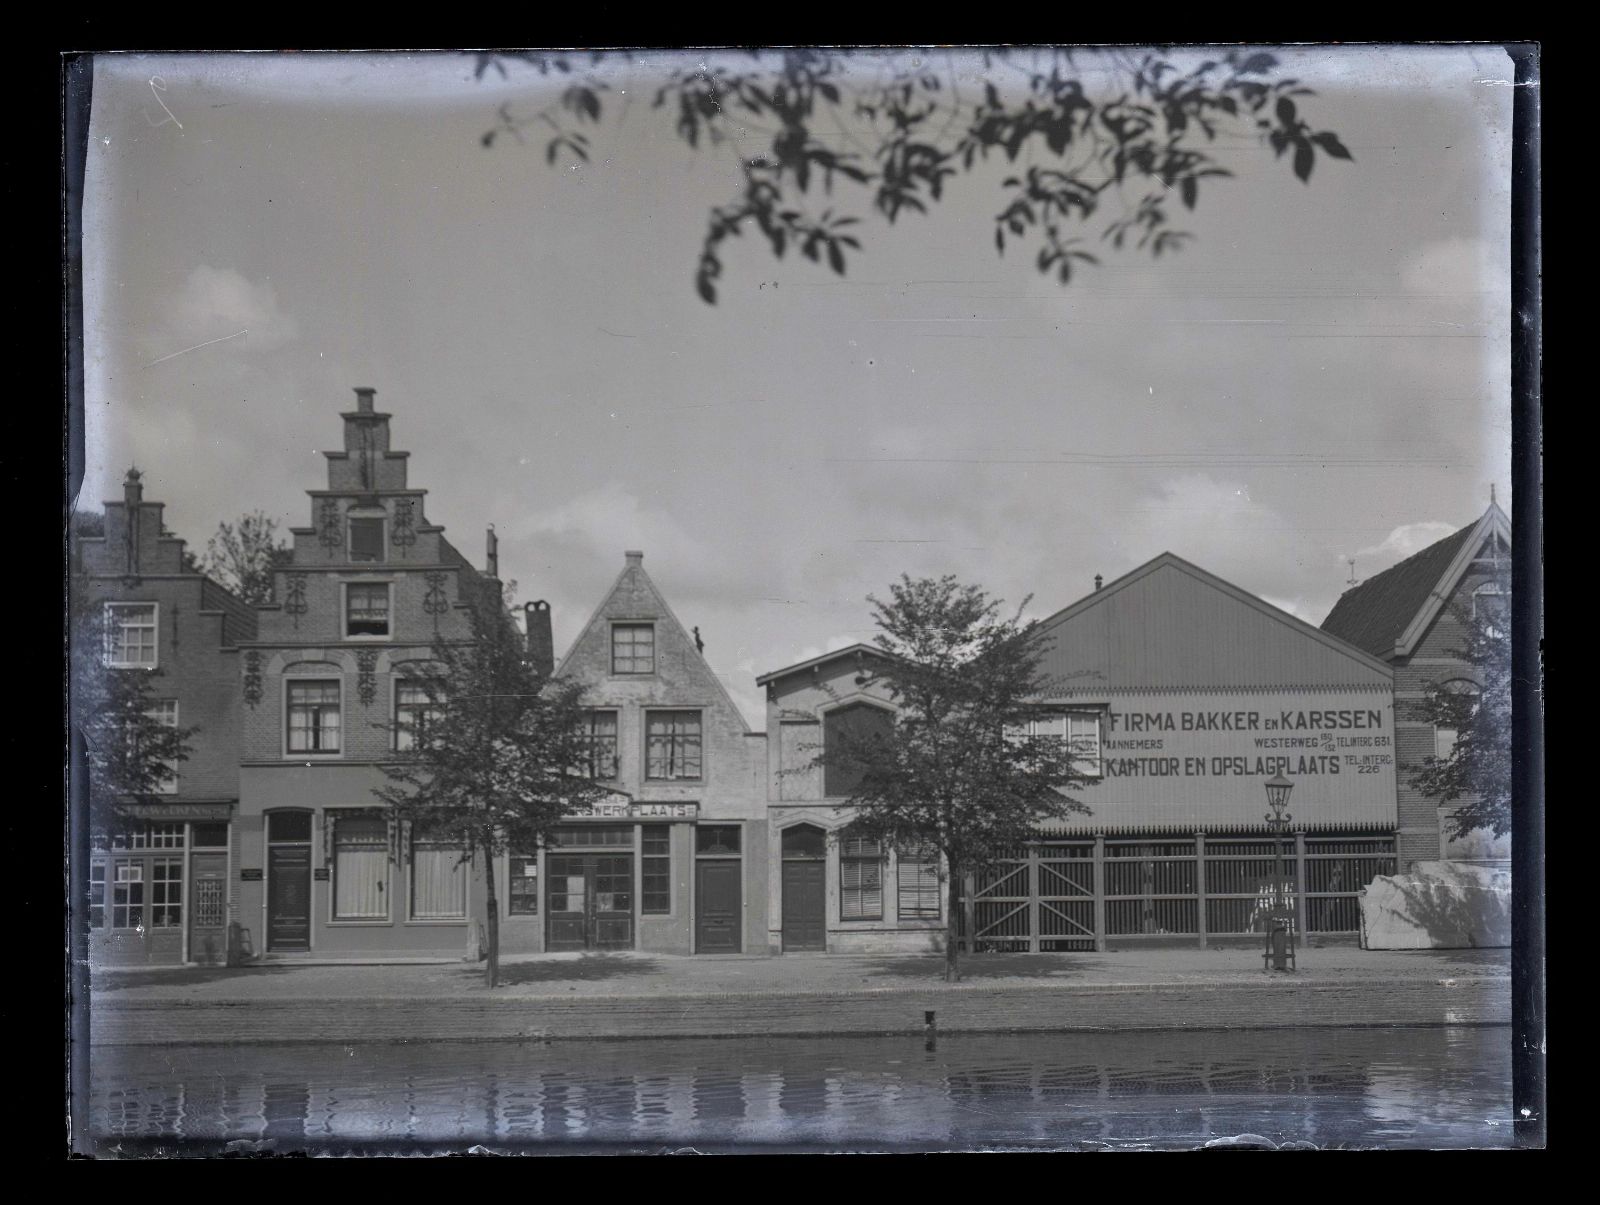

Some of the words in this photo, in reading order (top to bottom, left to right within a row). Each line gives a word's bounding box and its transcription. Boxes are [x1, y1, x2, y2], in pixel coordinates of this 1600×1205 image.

[1110, 712, 1176, 731] FIRMA
[1181, 711, 1259, 731] BAKKER
[1264, 719, 1278, 730] EN
[1281, 710, 1382, 730] KARSSEN
[1106, 739, 1164, 750] AANNEMERS
[1254, 737, 1318, 748] WESTERWEG
[1106, 757, 1180, 777] KANTOOR
[1185, 757, 1206, 776] EN
[1212, 755, 1340, 776] OPSLAGPLAATS
[1357, 765, 1380, 774] 226
